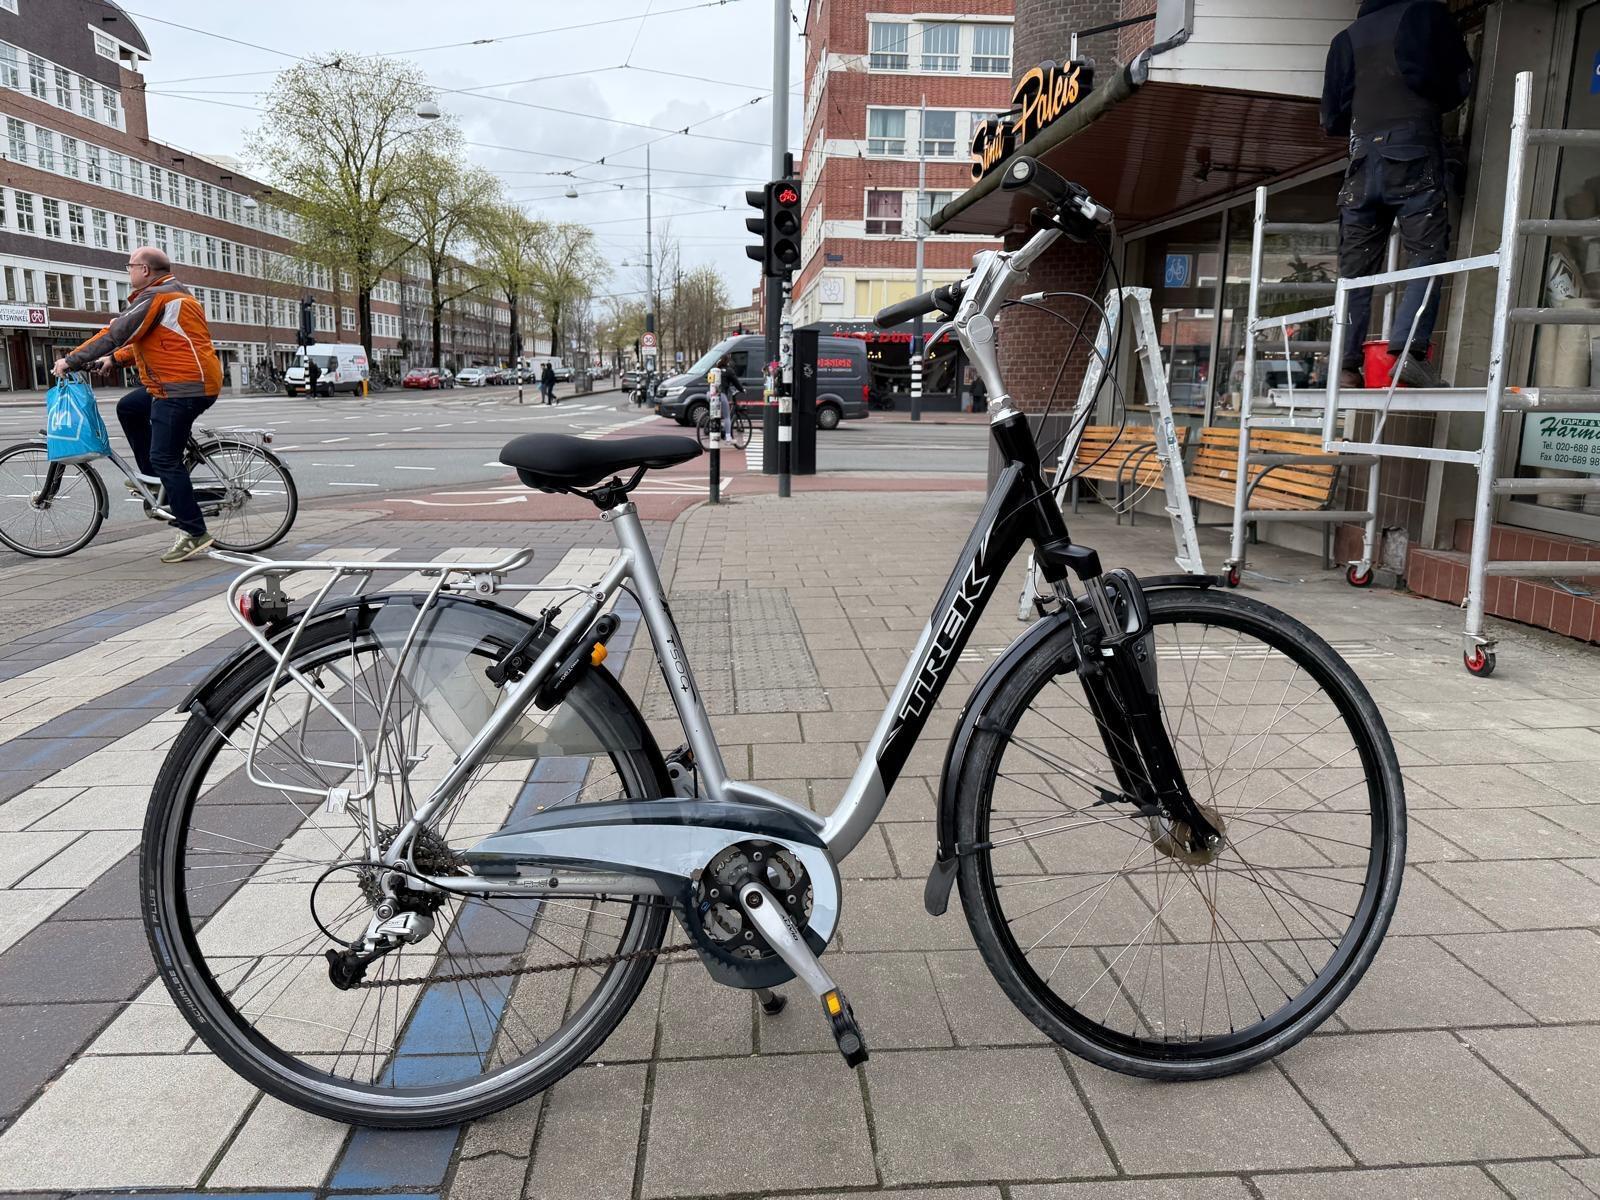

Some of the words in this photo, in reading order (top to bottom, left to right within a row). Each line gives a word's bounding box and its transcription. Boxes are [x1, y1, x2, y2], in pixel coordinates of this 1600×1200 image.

[1012, 60, 1081, 144] Paleis
[1540, 452, 1552, 461] Fax
[1554, 453, 1587, 465] 020-689
[1556, 442, 1588, 453] 020-689
[899, 557, 991, 720] TREK
[149, 887, 159, 924] PLUS
[168, 969, 207, 1024] SCHWALBE
